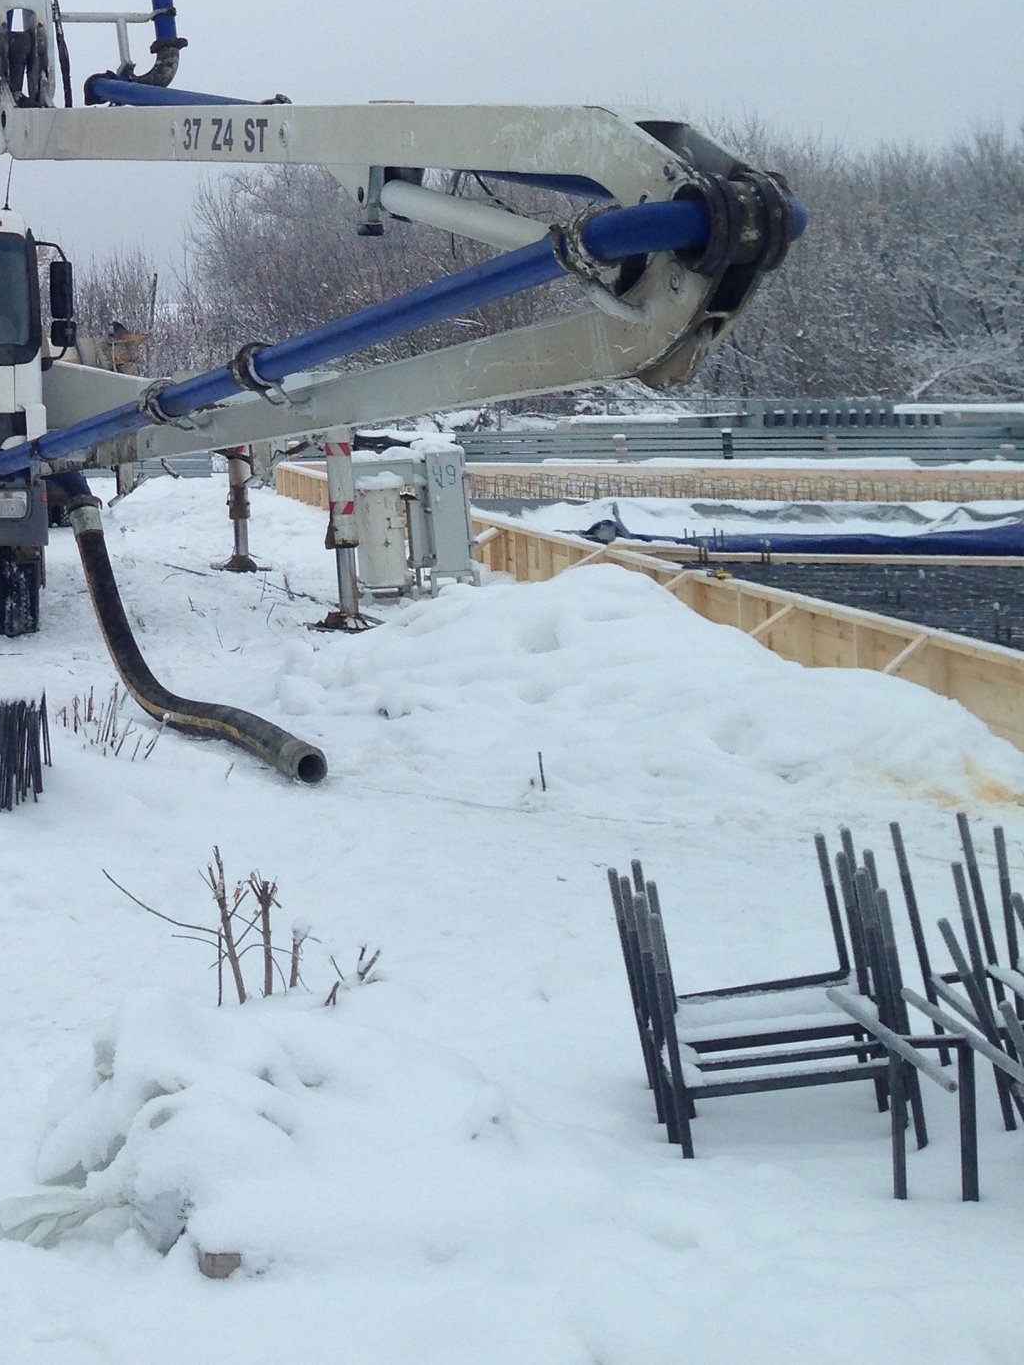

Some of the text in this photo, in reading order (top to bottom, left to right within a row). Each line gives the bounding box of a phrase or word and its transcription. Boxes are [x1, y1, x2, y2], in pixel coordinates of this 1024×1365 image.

[183, 117, 269, 153] 37 Z4 ST
